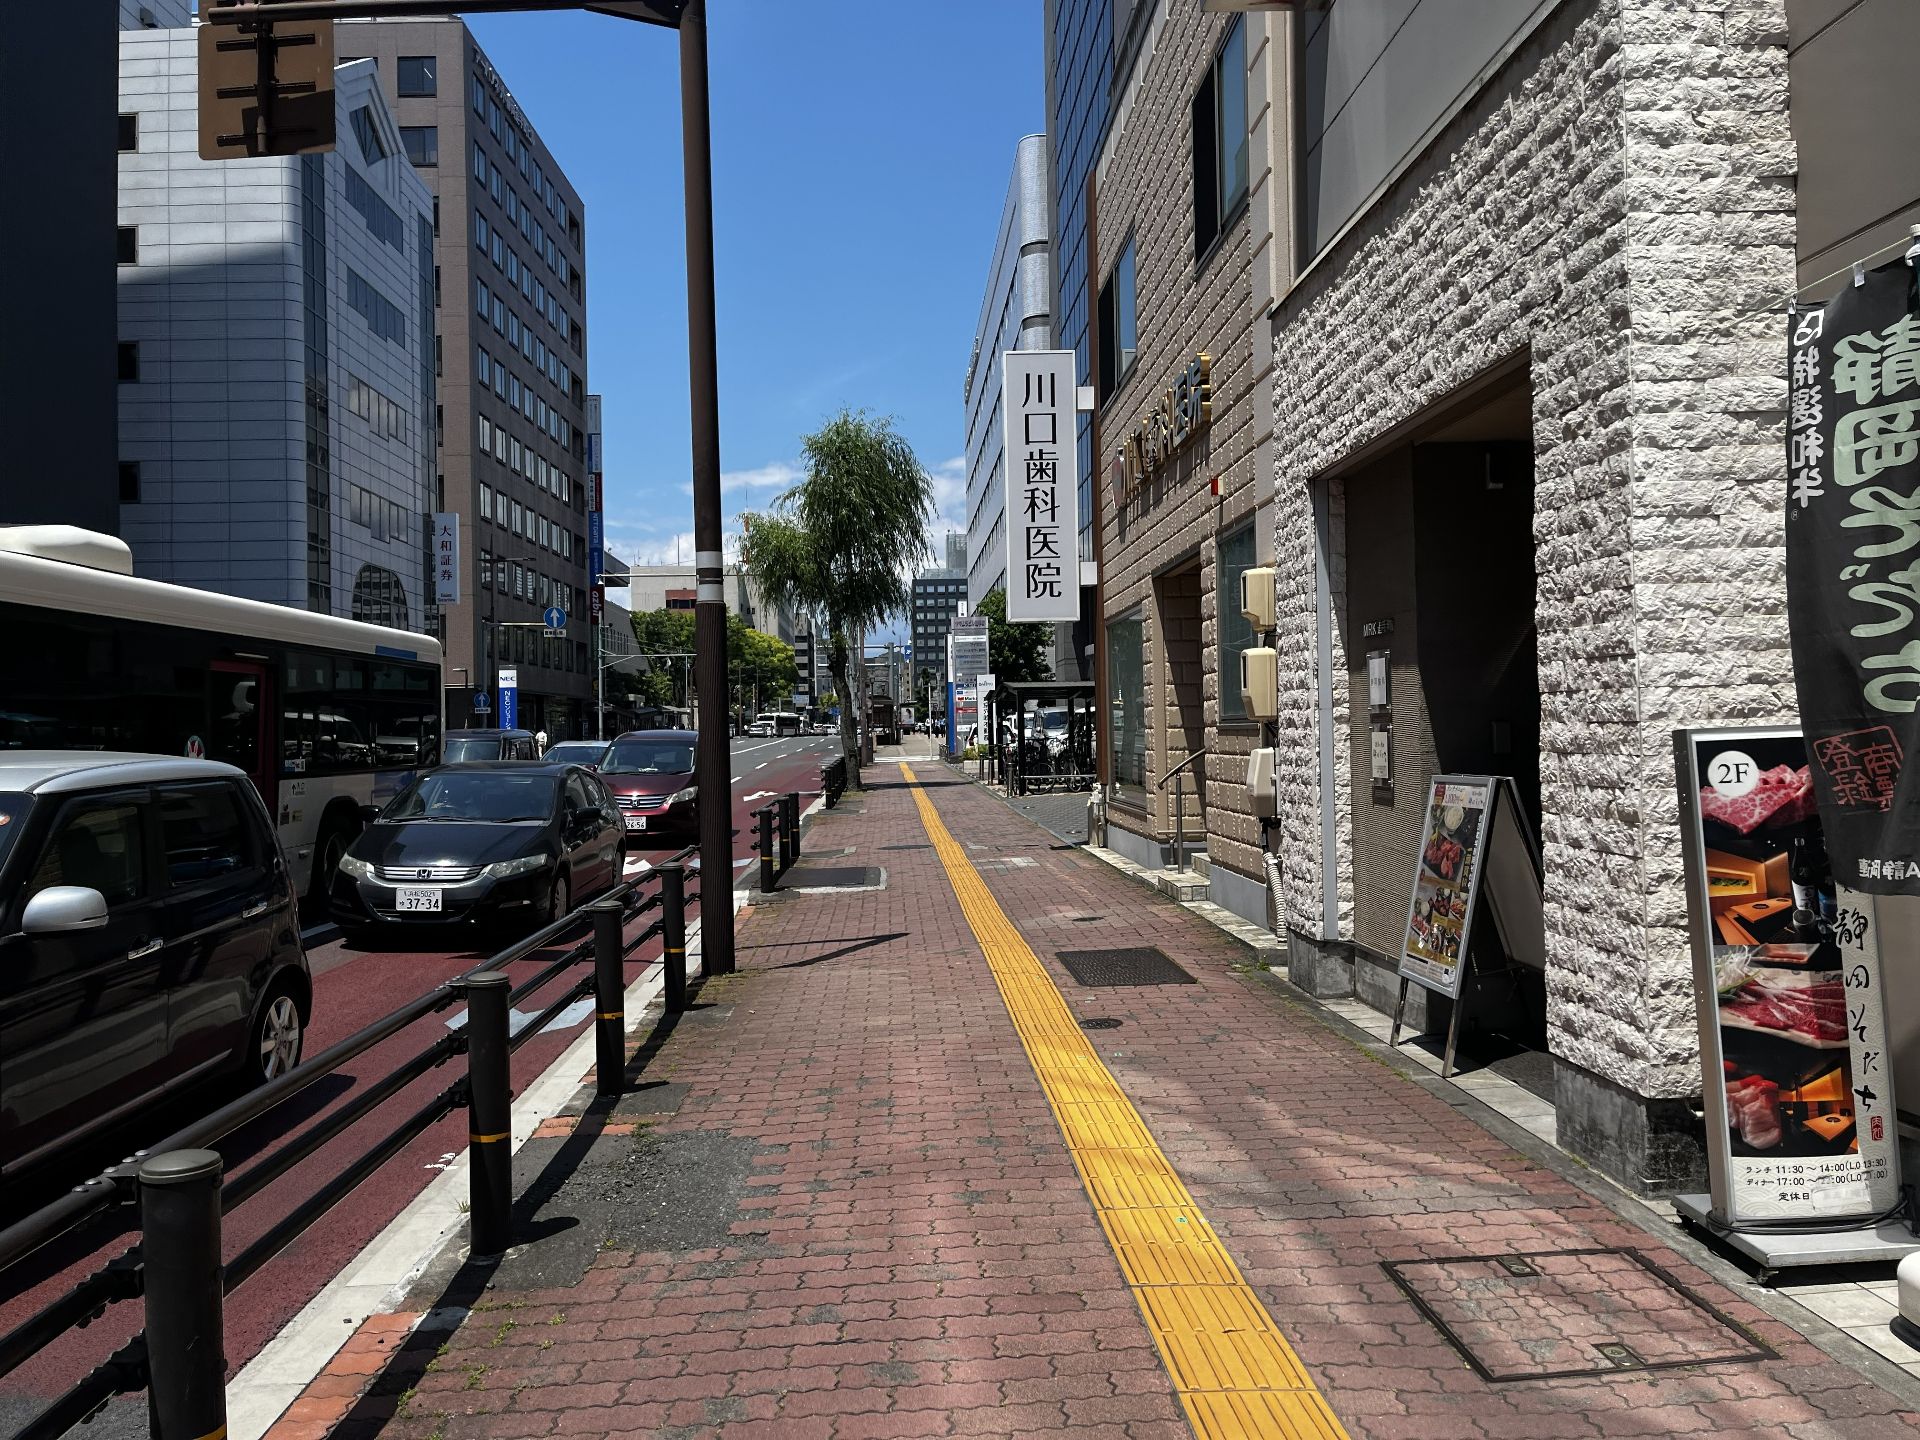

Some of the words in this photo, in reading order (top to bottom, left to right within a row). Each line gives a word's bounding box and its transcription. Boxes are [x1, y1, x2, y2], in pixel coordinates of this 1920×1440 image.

[1022, 373, 1062, 599] 川口歯科医院
[440, 525, 453, 581] 大和証券
[1718, 763, 1749, 784] 2F
[406, 898, 440, 910] 37-34
[1835, 908, 1880, 1112] 静岡そだち
[1746, 1166, 1772, 1174] ランチ
[1775, 1165, 1804, 1174] 11:30
[1776, 1177, 1805, 1186] 17:00
[1778, 1192, 1810, 1201] 定休日
